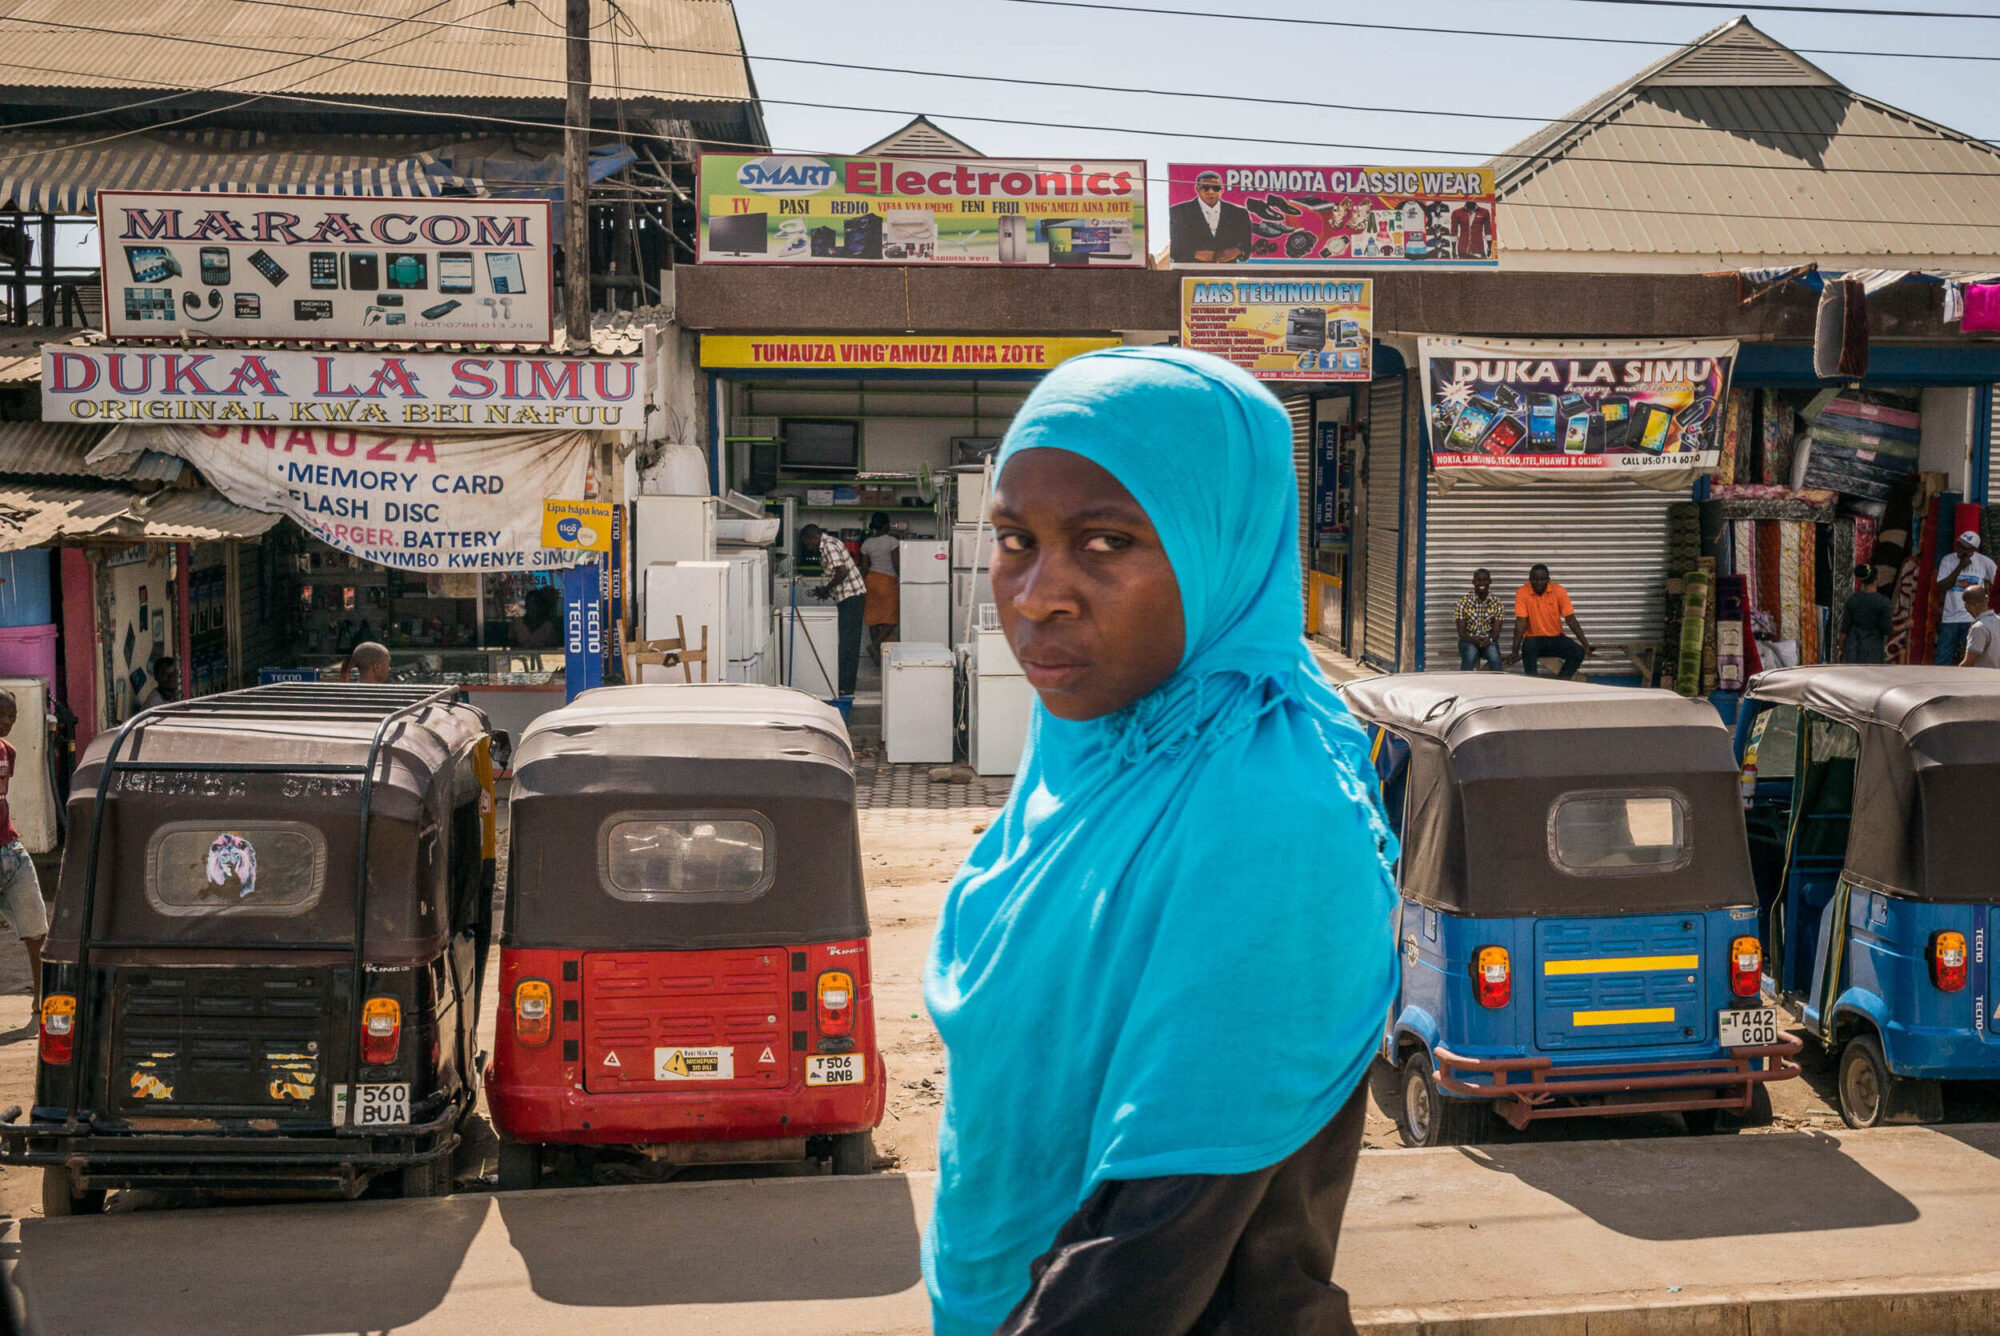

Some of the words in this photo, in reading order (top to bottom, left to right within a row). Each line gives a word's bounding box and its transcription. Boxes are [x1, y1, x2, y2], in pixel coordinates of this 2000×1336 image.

[738, 163, 834, 186] SMART
[844, 162, 1133, 197] Electronics
[1225, 169, 1327, 193] PROMOTA
[1331, 171, 1419, 194] CLASSIC
[1421, 173, 1481, 195] WEAR
[731, 197, 750, 214] TV
[779, 198, 810, 214] PASI
[830, 200, 870, 215] REDIO
[961, 200, 985, 213] FENI
[992, 201, 1020, 215] FRIJI
[1025, 201, 1079, 214] VING'AMUZI
[1082, 201, 1104, 213] AINA
[1106, 201, 1131, 213] ZOTE
[119, 207, 534, 248] MARACOM
[1192, 282, 1235, 304] AAS
[1237, 282, 1364, 305] TECHNOLOGY
[751, 343, 836, 362] TUNAUZA
[952, 344, 998, 363] AINA
[1001, 345, 1045, 363] ZOTE
[49, 351, 290, 398] DUKA
[313, 356, 422, 400] LA
[449, 358, 640, 403] SIMU
[1454, 359, 1560, 383] DUKA
[1568, 359, 1616, 383] LA
[1623, 358, 1712, 383] SIMU
[70, 397, 279, 422] ORIGINAL
[289, 399, 392, 424] KWA
[402, 403, 474, 424] BEI
[484, 404, 625, 427] NAFUU
[1577, 454, 1603, 466] OKING
[1621, 457, 1640, 466] CALL
[287, 461, 418, 493] MEMORY
[431, 473, 504, 495] CARD
[384, 501, 440, 523] DISC
[546, 502, 567, 515] Lipa
[568, 503, 591, 517] hapa
[591, 506, 610, 517] kwa
[1324, 490, 1332, 523] TECNO
[612, 508, 621, 541] TECNO
[403, 530, 502, 548] BATTERY
[364, 548, 440, 568] NYIMBO
[448, 551, 525, 569] KWENYE
[532, 549, 576, 566] SIMU
[613, 568, 621, 599] TECNO
[569, 599, 582, 653] TECNO
[587, 599, 601, 653] TECNO
[270, 674, 303, 683] TECNO
[1976, 927, 1984, 963] TECNO
[364, 965, 401, 973] KING
[1731, 1010, 1775, 1027] T442
[1976, 994, 1984, 1031] TECNO
[1742, 1027, 1775, 1044] CQD
[816, 1056, 852, 1069] T506
[826, 1069, 853, 1083] BNB
[362, 1104, 406, 1123] BUA
